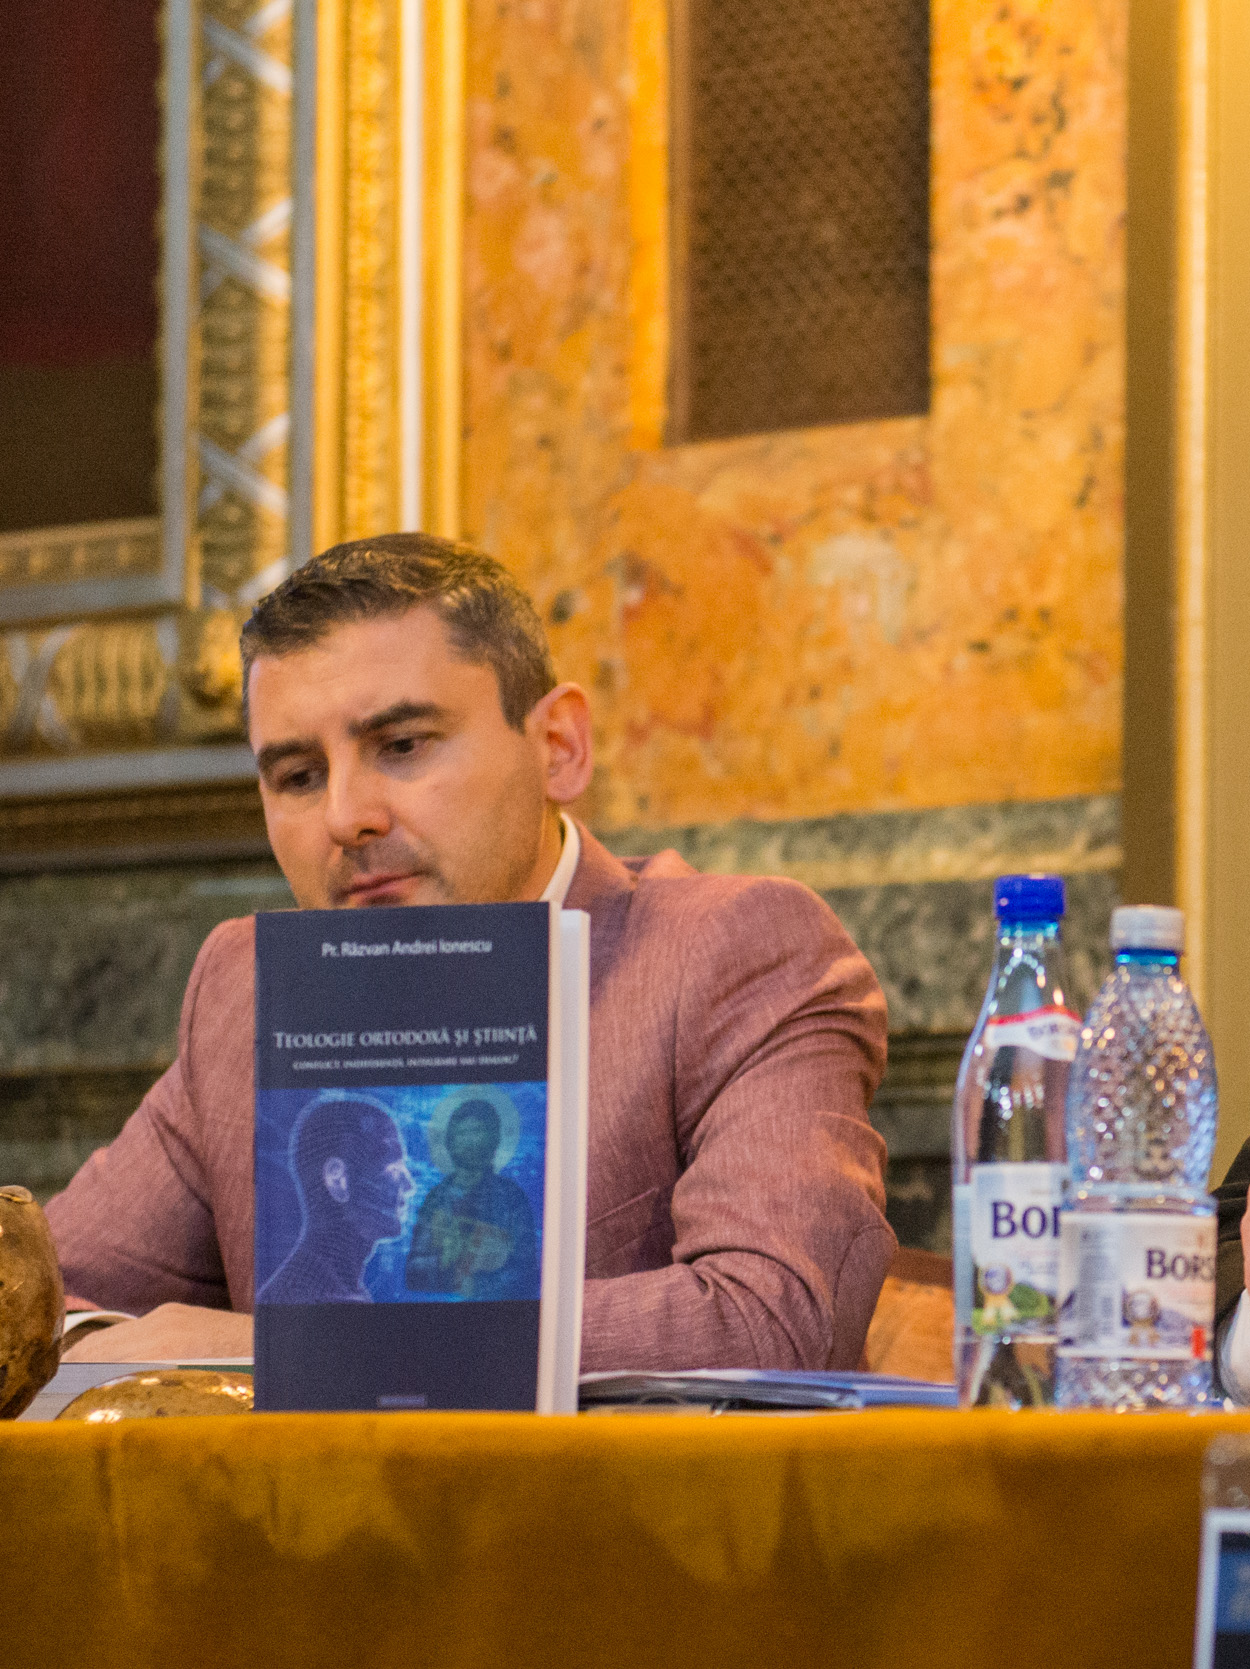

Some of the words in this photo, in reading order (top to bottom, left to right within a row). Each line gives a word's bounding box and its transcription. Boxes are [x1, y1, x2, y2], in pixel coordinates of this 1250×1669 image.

[392, 939, 438, 955] Andrei
[439, 938, 493, 954] Ionescu
[273, 1031, 356, 1049] TEOLOGIE
